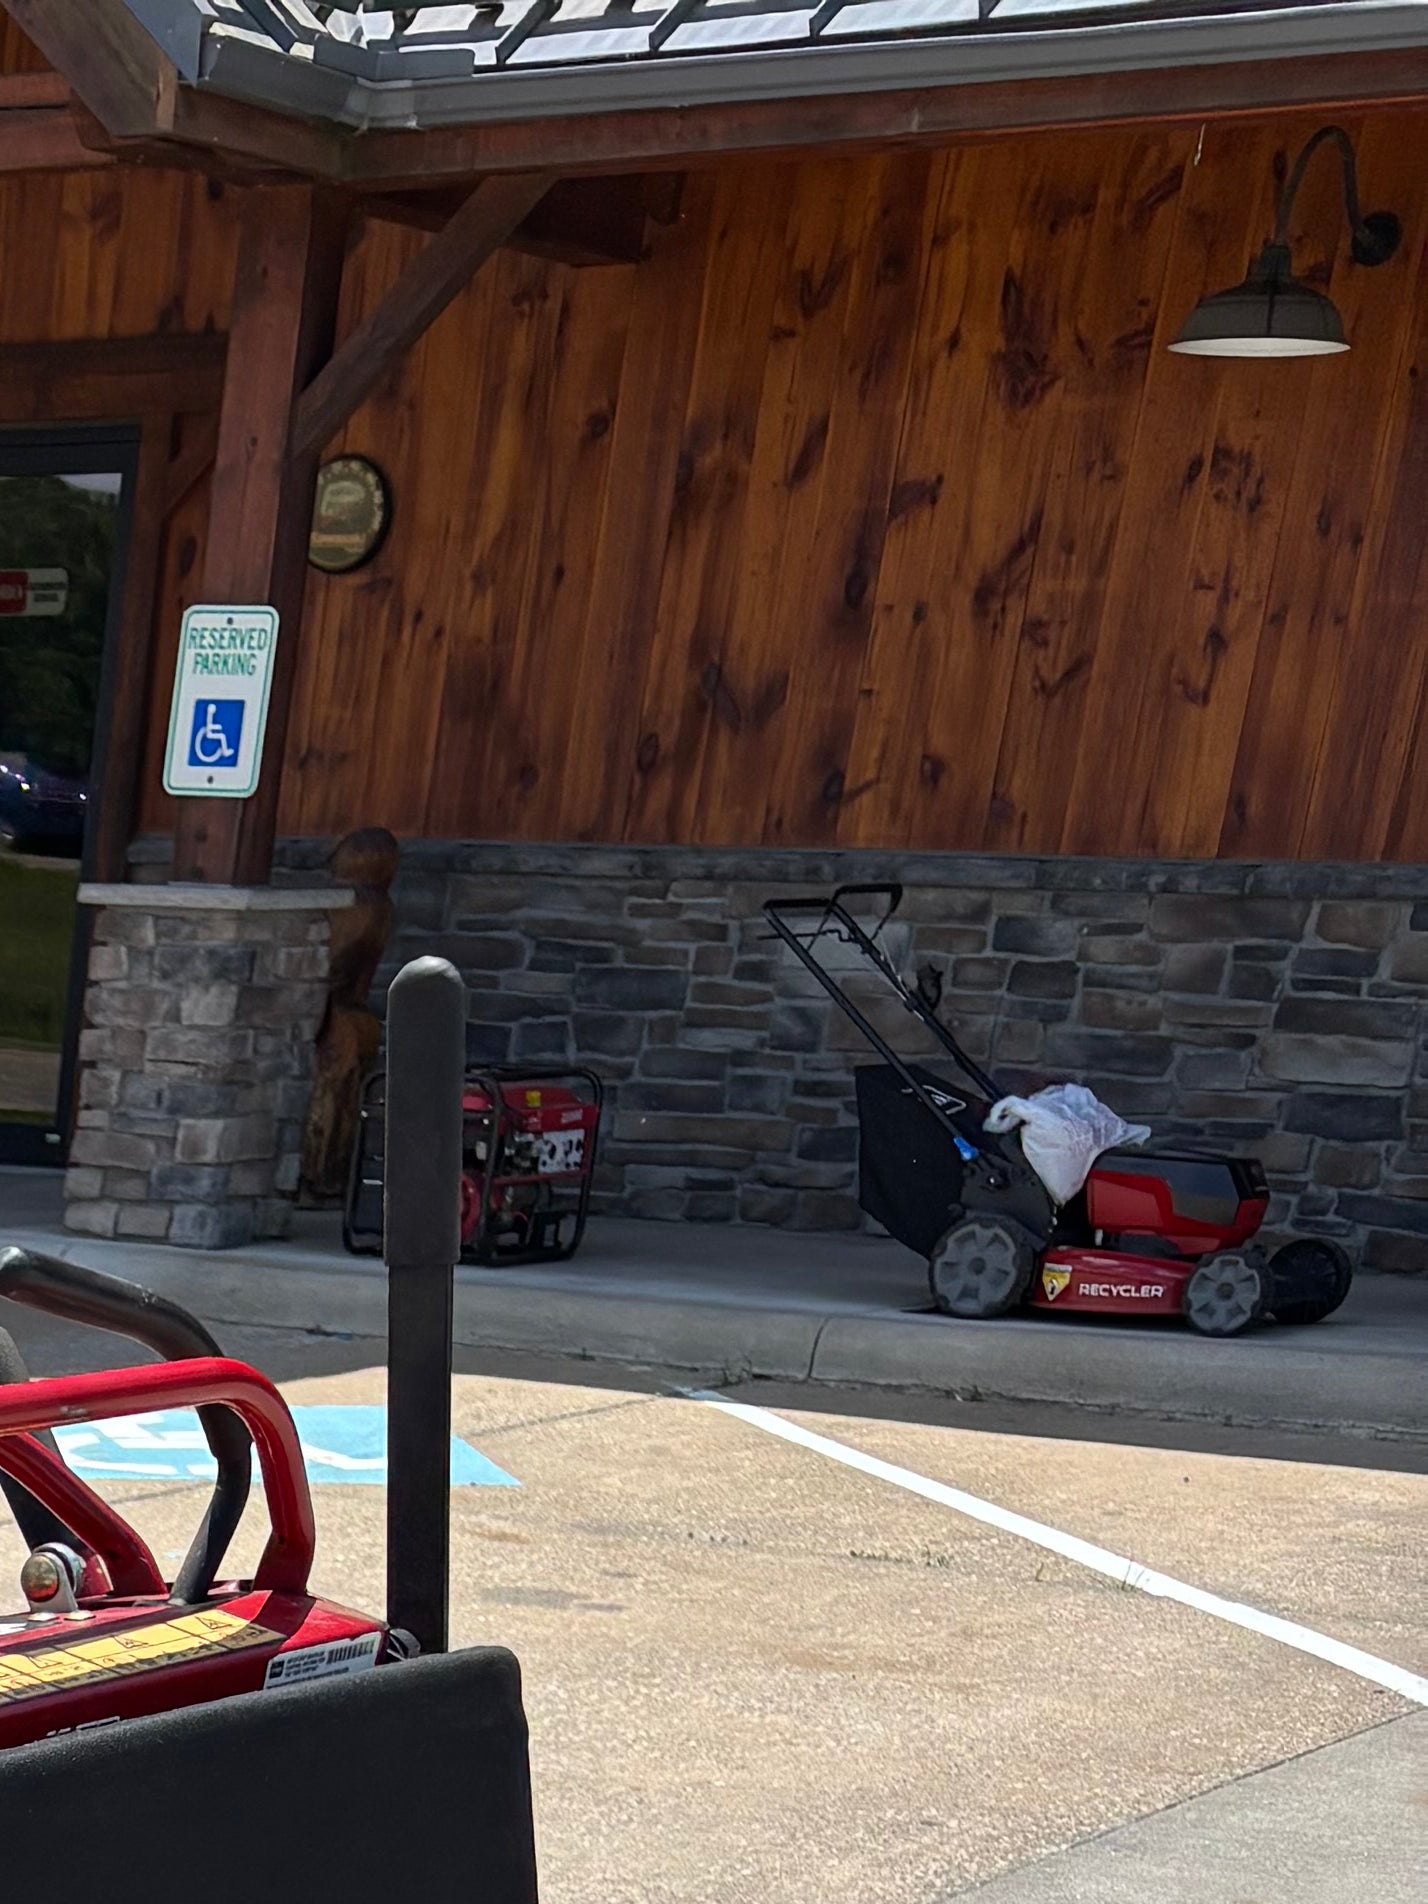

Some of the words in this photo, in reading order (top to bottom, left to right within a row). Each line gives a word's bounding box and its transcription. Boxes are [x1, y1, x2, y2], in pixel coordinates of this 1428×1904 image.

[188, 627, 268, 651] RESERVED
[192, 652, 258, 676] PARKING
[1078, 1283, 1164, 1298] RECYCLER
